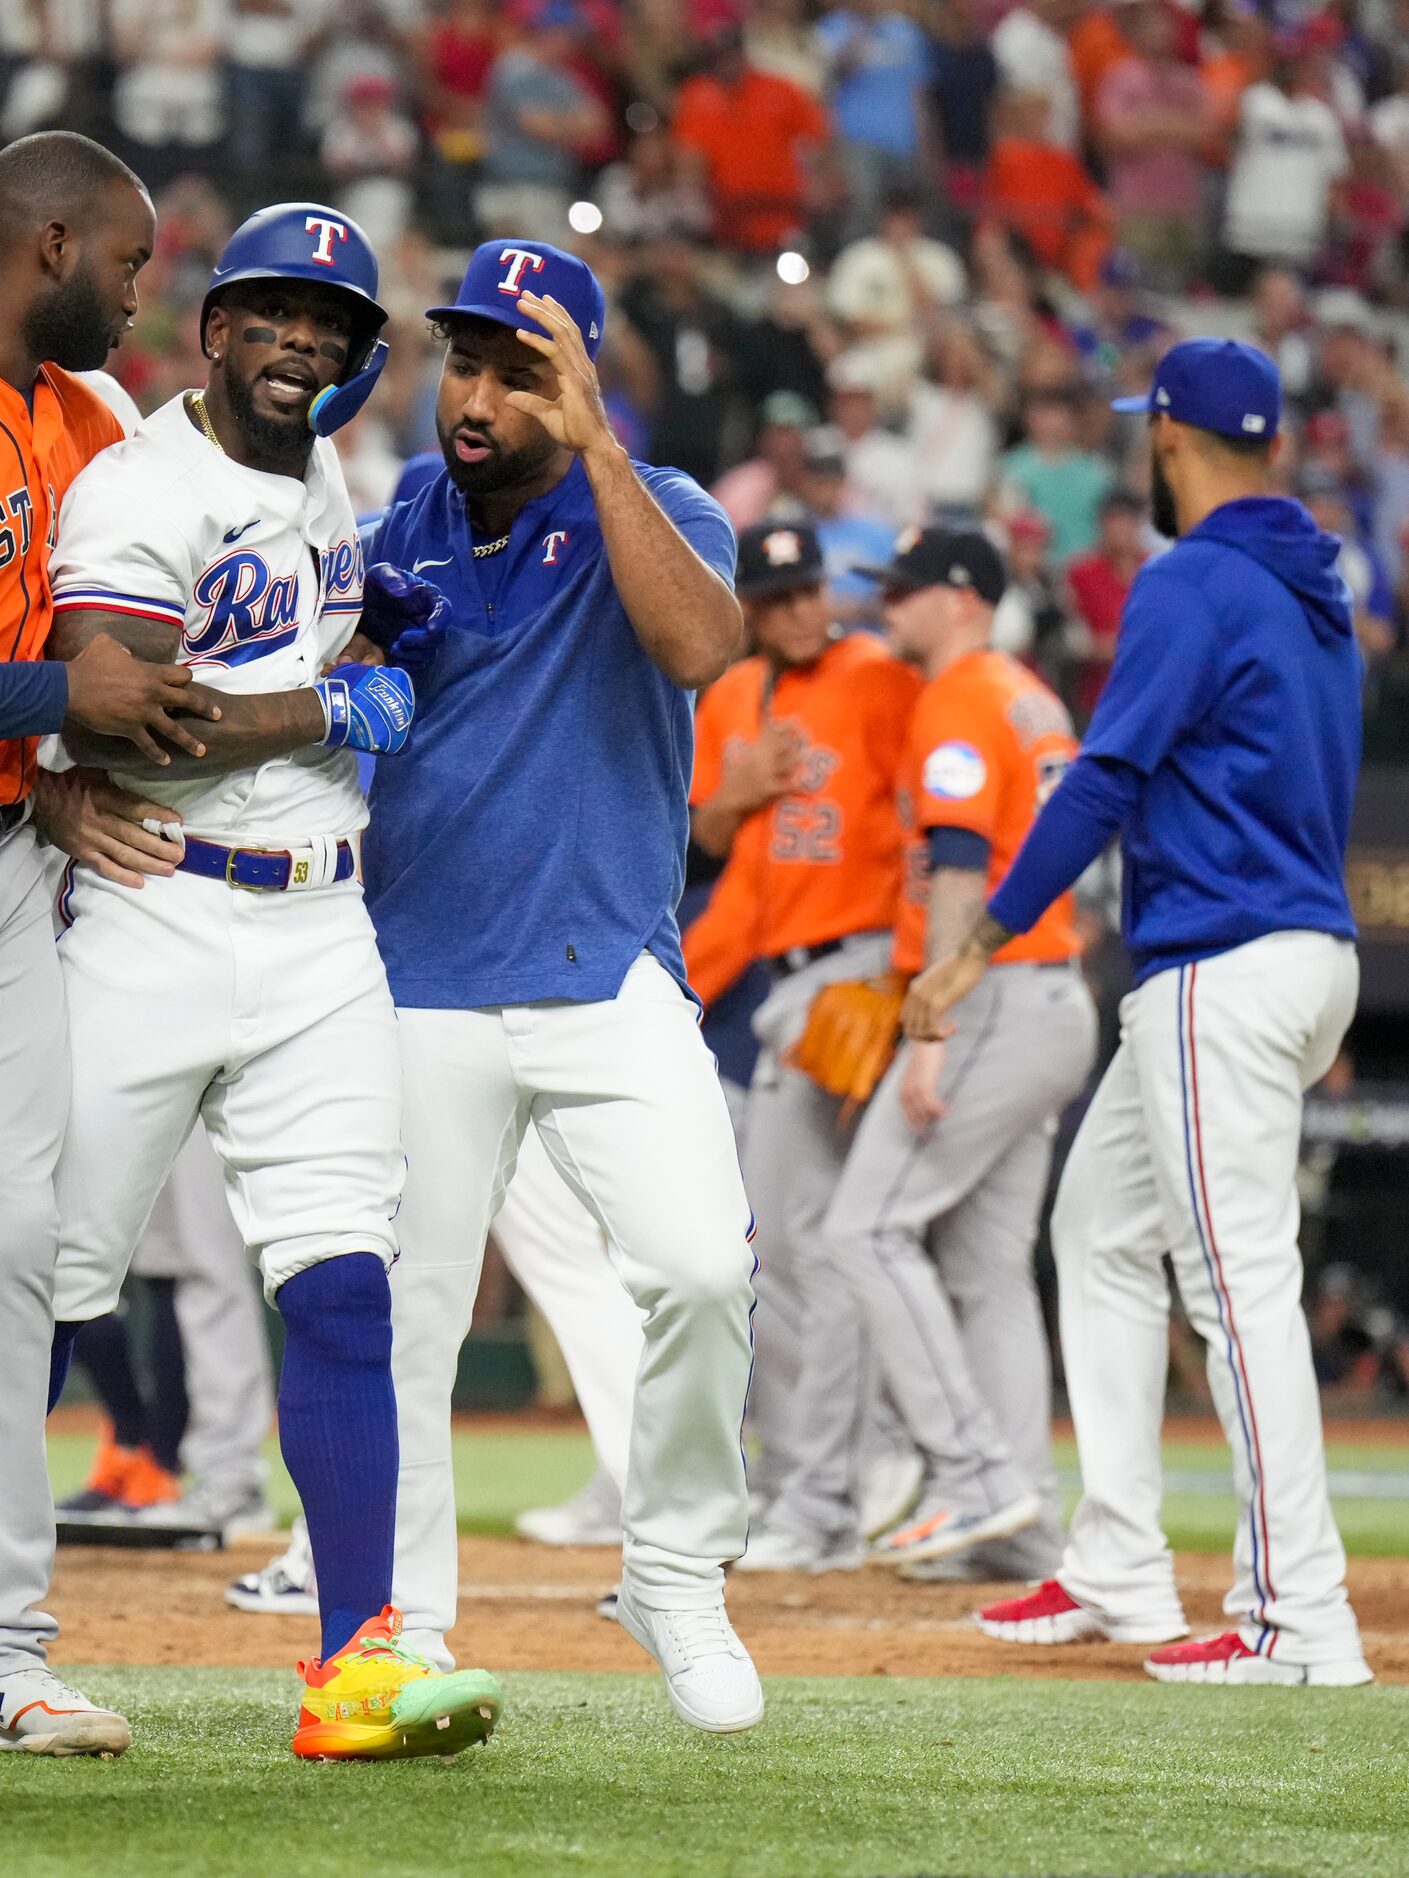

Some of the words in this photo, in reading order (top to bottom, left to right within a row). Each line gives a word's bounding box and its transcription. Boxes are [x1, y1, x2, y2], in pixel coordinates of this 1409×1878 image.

[305, 216, 348, 267] T
[497, 248, 545, 296] T
[542, 531, 569, 566] T
[368, 683, 407, 727] Franklin
[768, 804, 844, 864] 52
[293, 860, 309, 884] 53
